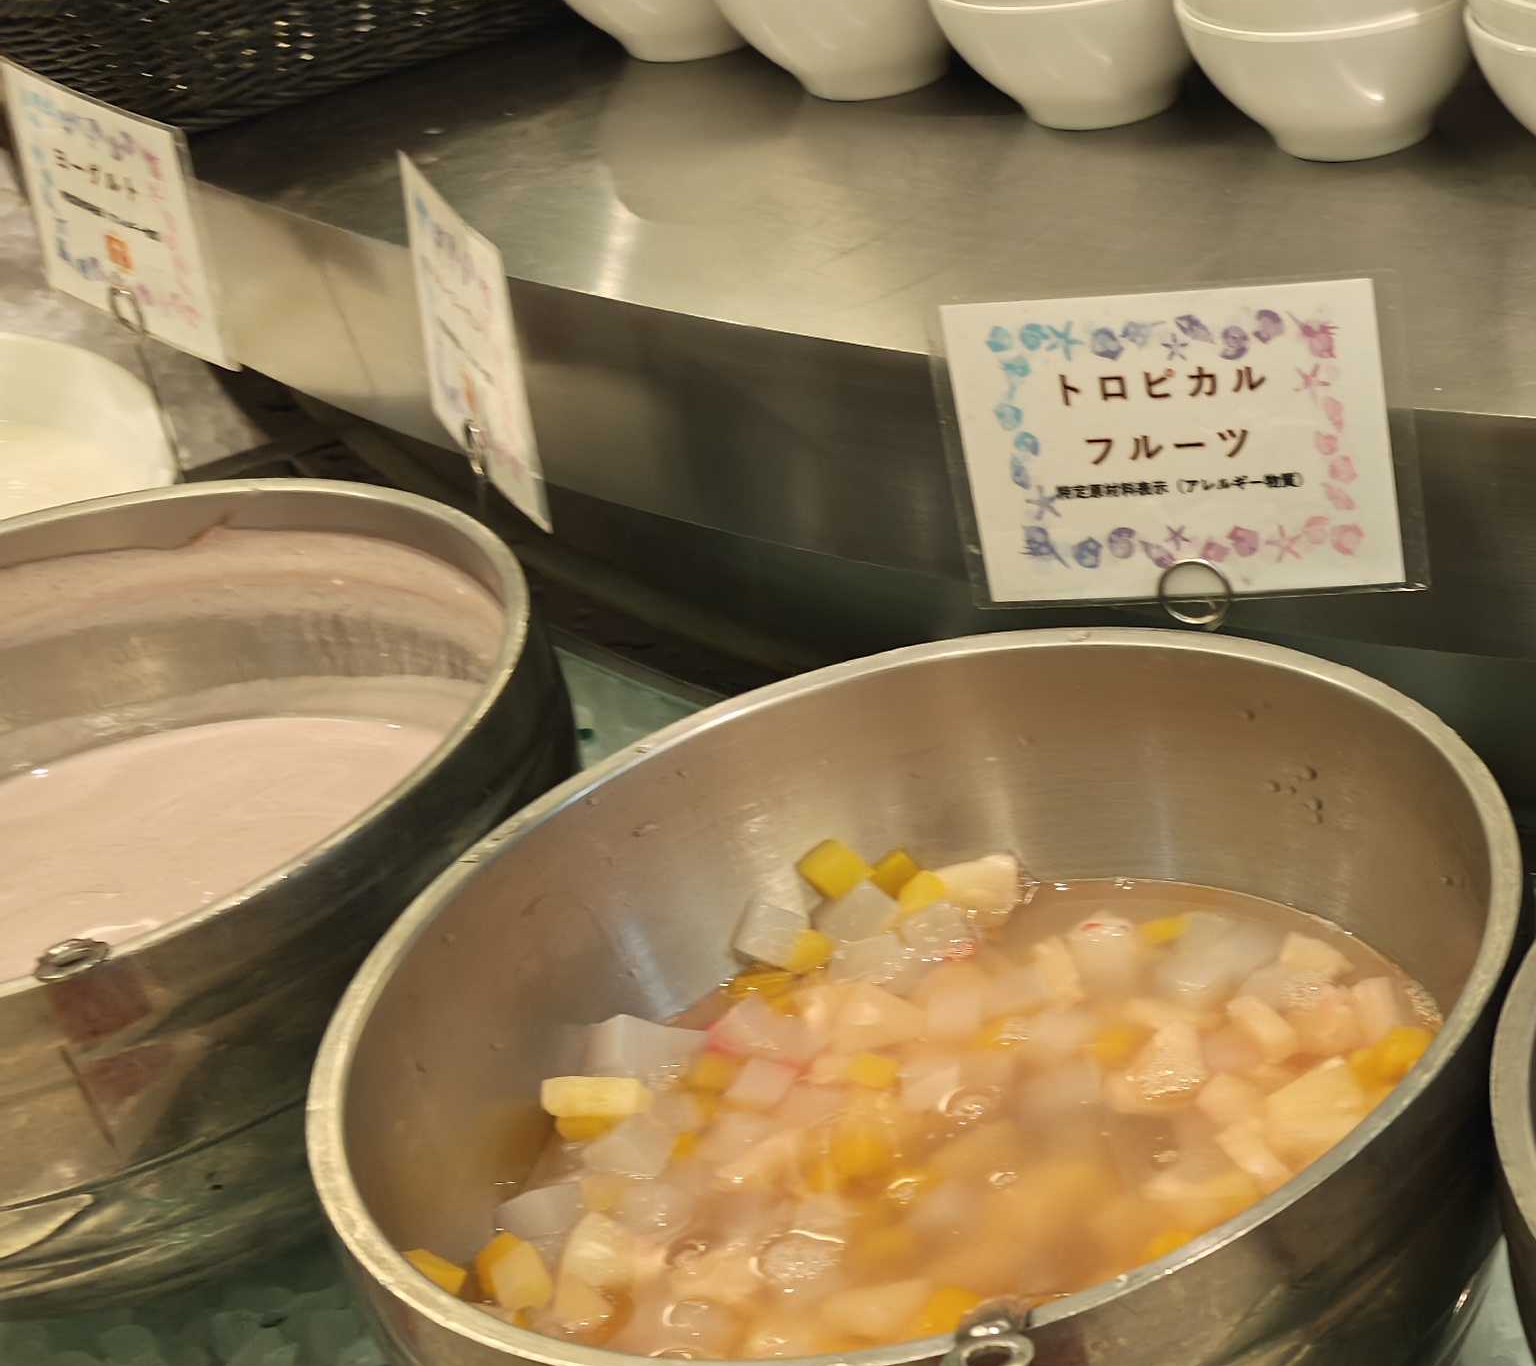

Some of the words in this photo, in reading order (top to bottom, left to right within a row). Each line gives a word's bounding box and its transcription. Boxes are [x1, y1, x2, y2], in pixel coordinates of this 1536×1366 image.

[1058, 366, 1267, 407] トロピカル
[1085, 427, 1250, 466] フルーツ
